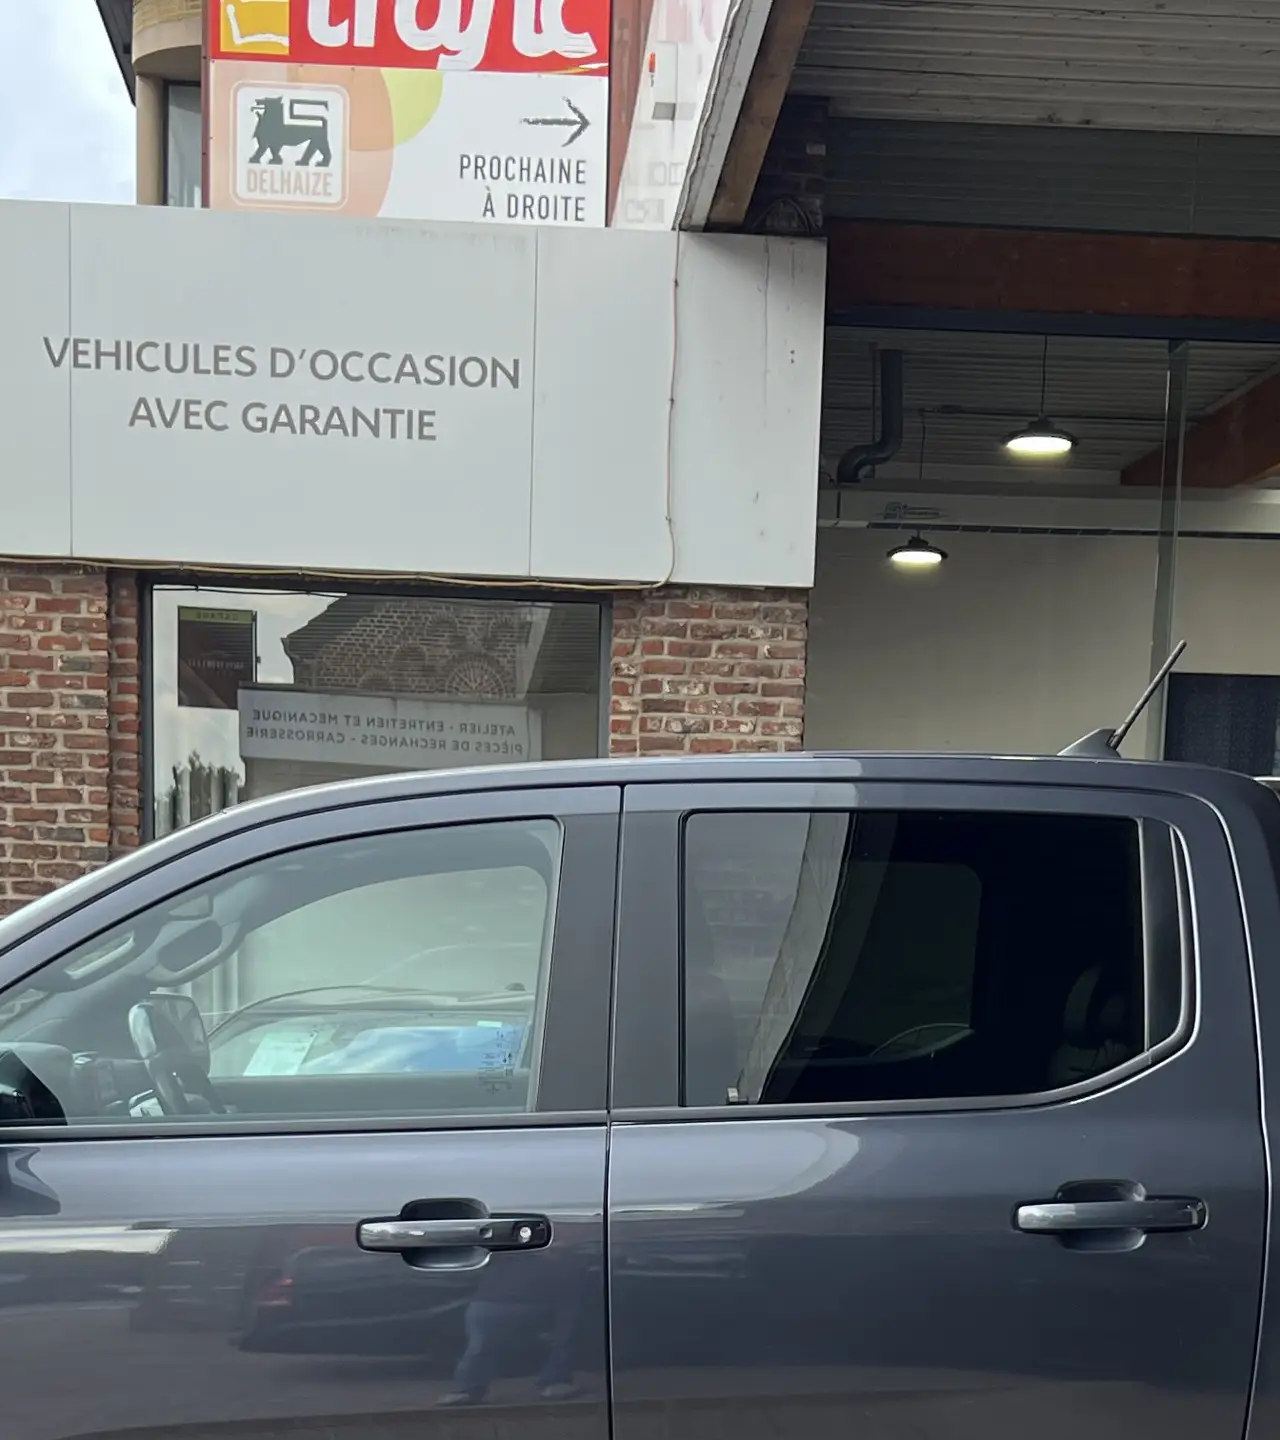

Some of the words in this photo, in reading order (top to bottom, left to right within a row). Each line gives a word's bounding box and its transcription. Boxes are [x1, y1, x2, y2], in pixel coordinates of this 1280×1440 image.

[246, 166, 333, 197] DELHAIZE
[458, 153, 587, 185] PROCHAINE
[482, 184, 497, 218] À
[506, 188, 586, 222] DROITE
[42, 336, 258, 378] VEHICULES
[269, 346, 521, 390] D'OCCASION
[127, 396, 230, 432] AVEC
[240, 402, 438, 441] GARANTIE
